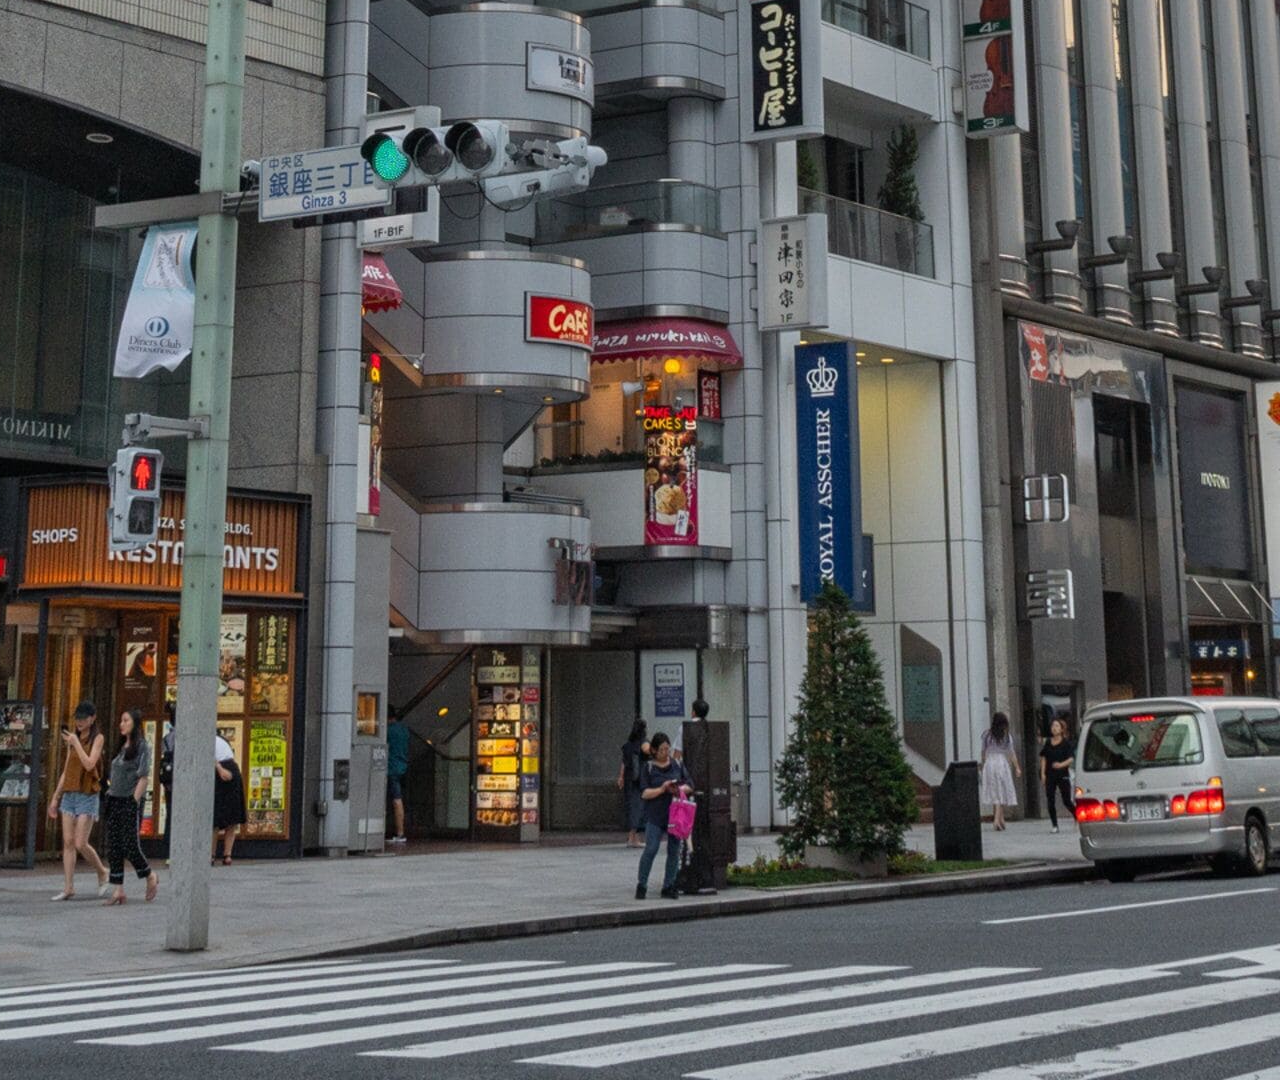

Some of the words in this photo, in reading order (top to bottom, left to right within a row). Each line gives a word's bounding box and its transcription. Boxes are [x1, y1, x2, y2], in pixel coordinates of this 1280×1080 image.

[758, 4, 786, 126] コーヒー屋
[269, 154, 303, 170] 中央区
[301, 194, 334, 210] Ginza
[339, 191, 347, 205] 3
[129, 335, 158, 347] Diners
[159, 337, 182, 349] Club
[645, 406, 670, 419] TAKE
[644, 418, 682, 431] CAKES
[647, 433, 683, 447] MONT
[647, 445, 683, 457] BLANC
[816, 407, 832, 509] ASSCHER
[32, 527, 78, 545] SHOPS
[108, 539, 280, 572] RESTAANTS
[1198, 646, 1238, 658] モトキ
